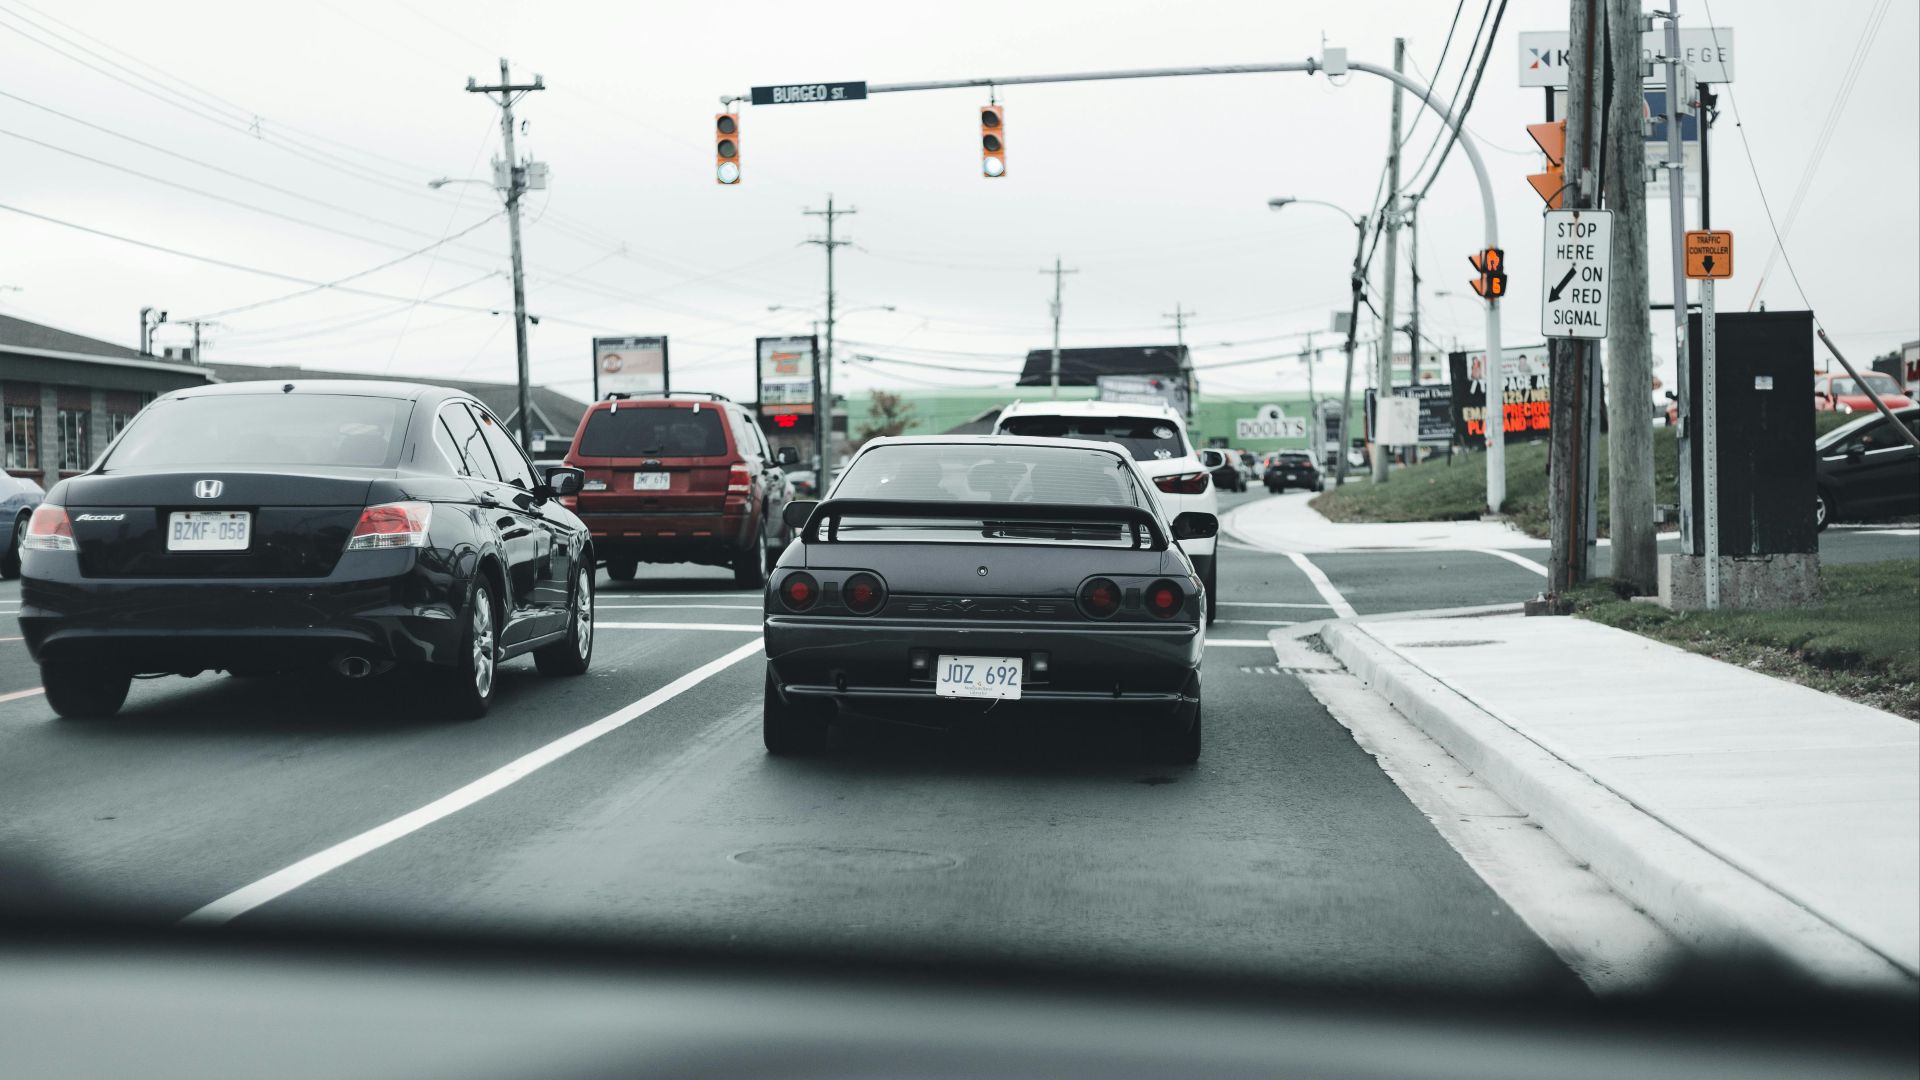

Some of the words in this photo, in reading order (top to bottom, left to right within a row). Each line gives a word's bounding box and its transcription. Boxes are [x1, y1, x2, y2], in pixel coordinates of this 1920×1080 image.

[831, 87, 848, 100] ST.
[1558, 222, 1597, 238] STOP
[1697, 236, 1721, 244] TRAFFIC
[1557, 244, 1595, 260] HERE
[1689, 246, 1729, 255] CONTROLLER
[1582, 266, 1603, 282] ON
[1572, 288, 1602, 304] RED
[1553, 309, 1602, 327] SIGNAL
[1240, 420, 1305, 437] DOOLY'S
[75, 513, 126, 522] Accord
[907, 601, 1057, 613] SKYLINE
[942, 664, 975, 685] JOZ
[985, 666, 1018, 687] 692
